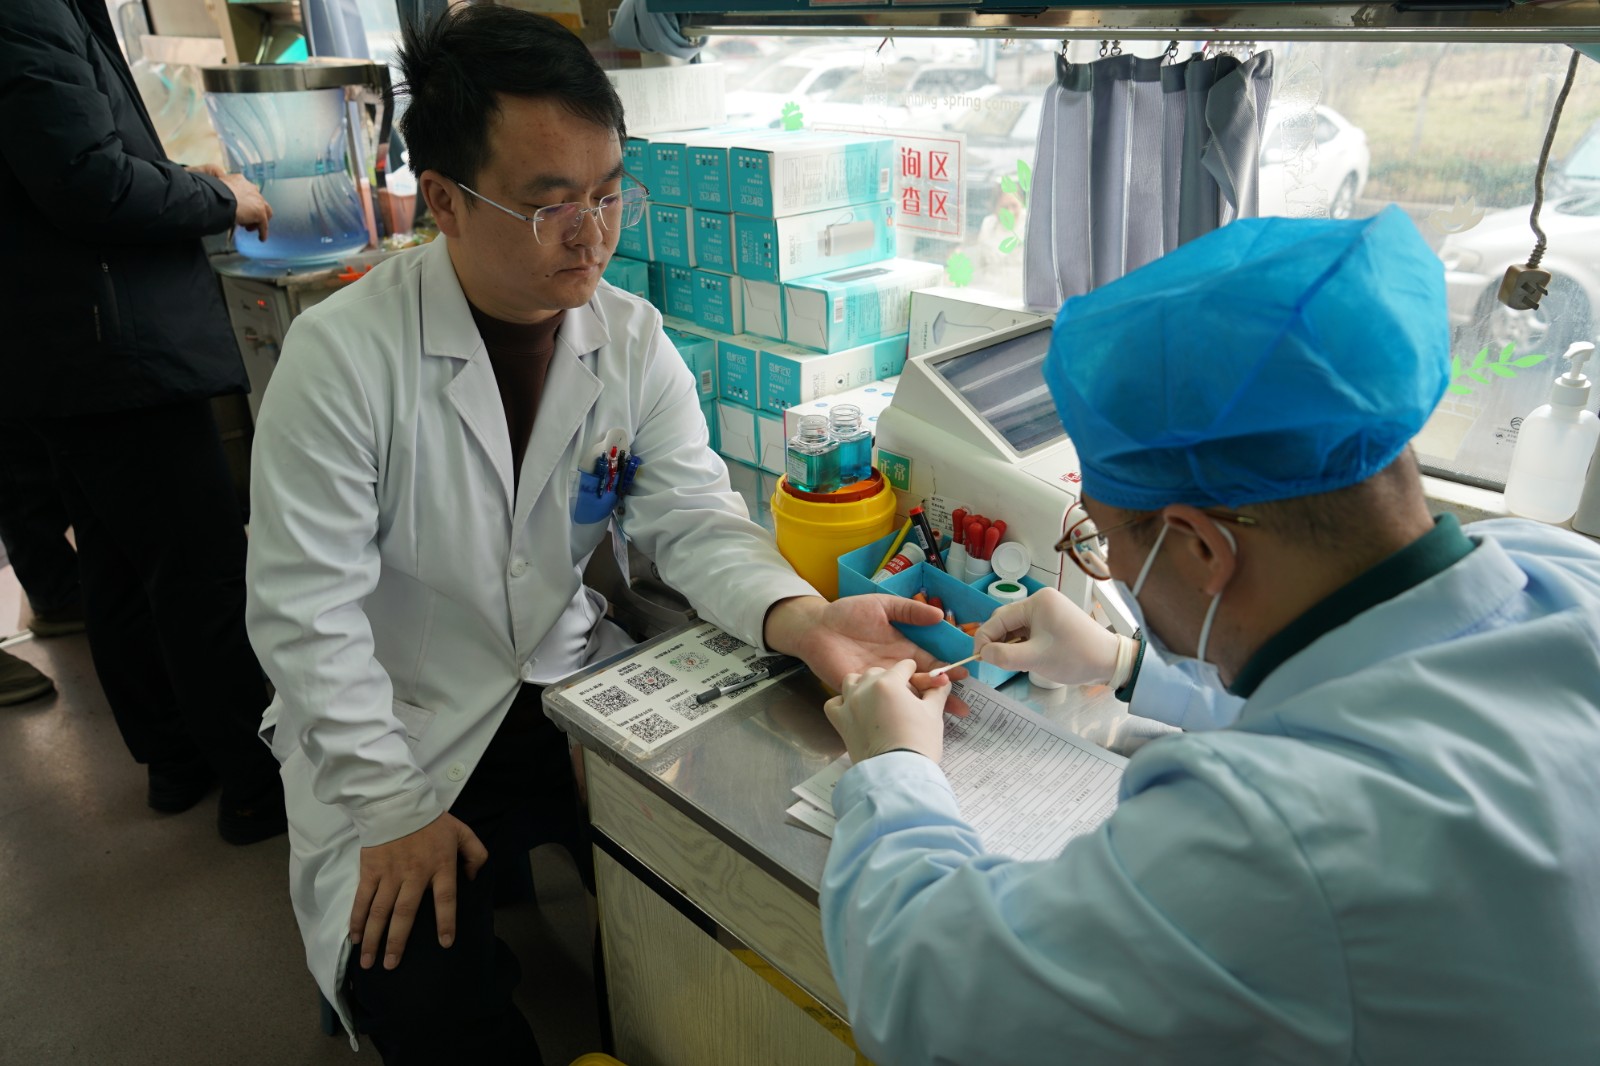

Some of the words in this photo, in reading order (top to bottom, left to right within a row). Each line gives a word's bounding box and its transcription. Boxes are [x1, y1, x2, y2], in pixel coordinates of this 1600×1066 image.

[943, 93, 981, 111] spring
[984, 99, 1020, 112] come
[901, 146, 949, 181] 询区
[901, 186, 949, 220] 查区
